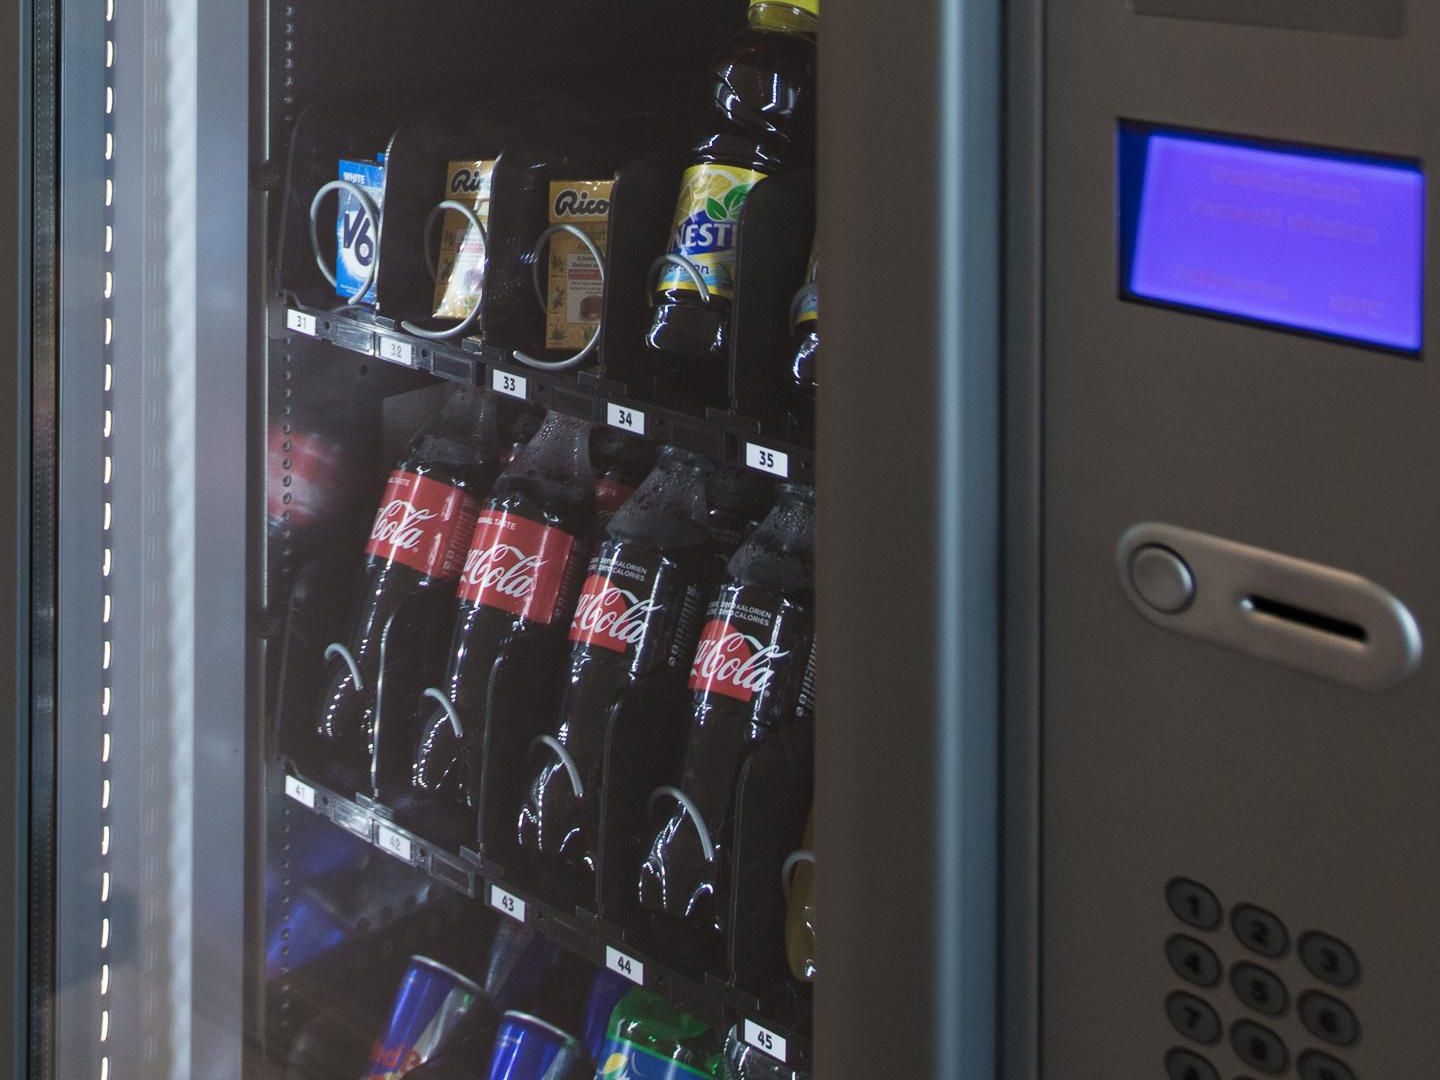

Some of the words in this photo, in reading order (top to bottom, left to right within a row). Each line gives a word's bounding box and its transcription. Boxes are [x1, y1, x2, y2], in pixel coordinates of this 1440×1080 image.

[343, 171, 366, 185] WHITE
[554, 189, 609, 217] Rico
[343, 202, 374, 267] V6
[391, 343, 402, 358] 32
[503, 376, 516, 391] 33
[618, 409, 632, 427] 34
[759, 450, 774, 468] 35
[734, 611, 770, 626] CALORIES
[736, 604, 772, 619] KALORIEN
[295, 784, 305, 800] 41
[390, 834, 401, 851] 42
[502, 895, 514, 912] 43
[617, 955, 632, 975] 44
[757, 1030, 773, 1050] 45
